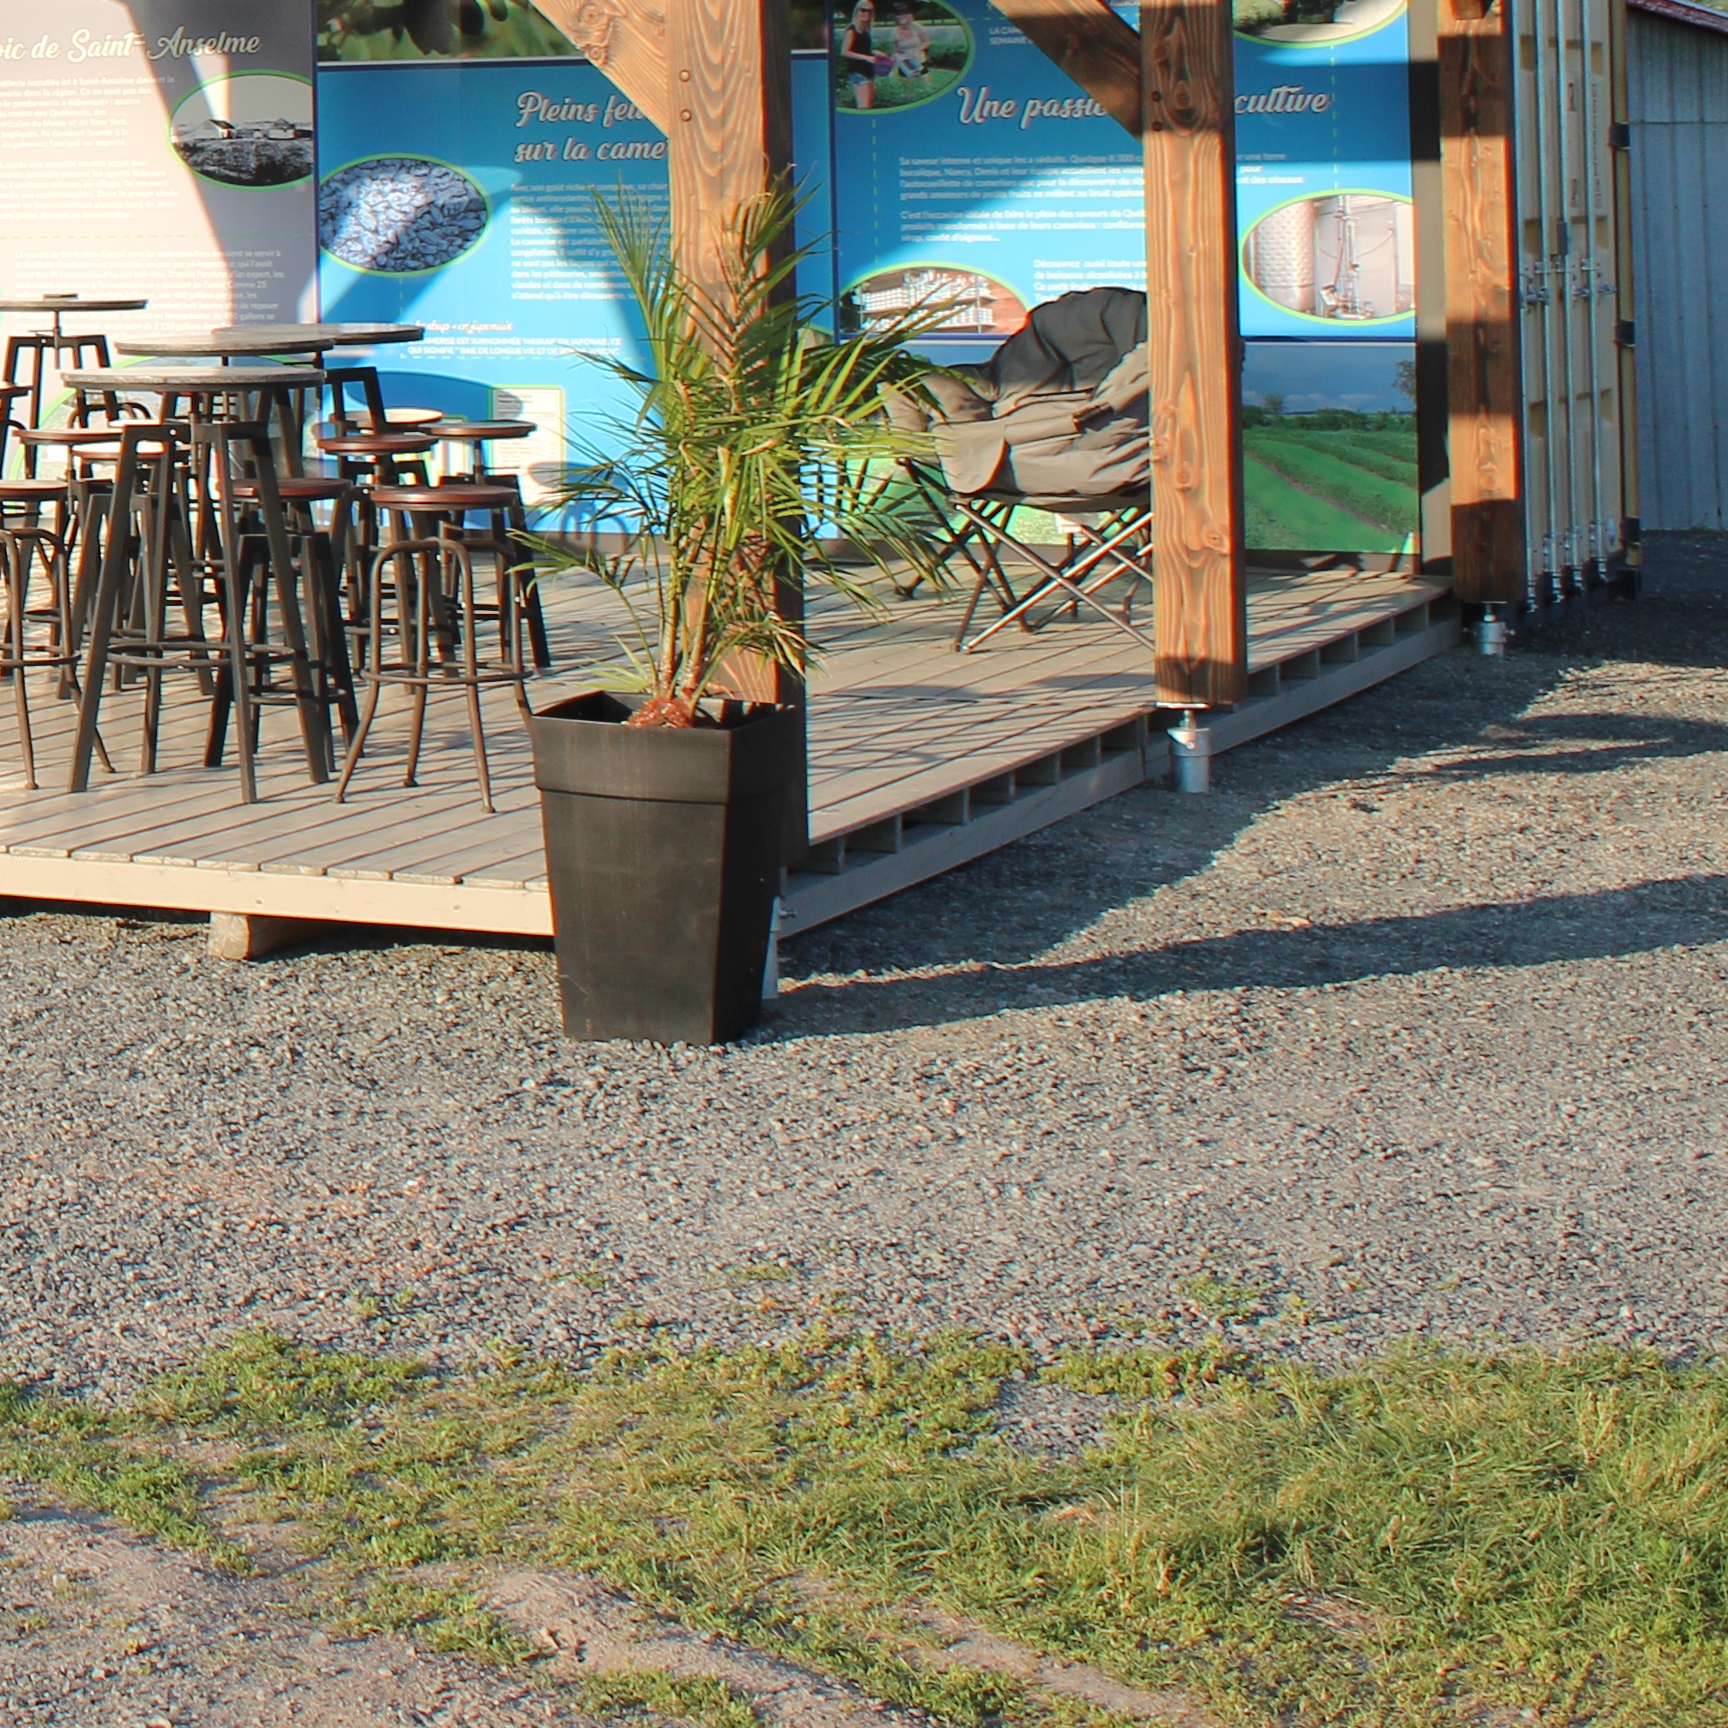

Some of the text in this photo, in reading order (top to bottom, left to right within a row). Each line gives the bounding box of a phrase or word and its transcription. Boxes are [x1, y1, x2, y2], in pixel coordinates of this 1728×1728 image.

[31, 35, 60, 59] de
[515, 90, 645, 128] Pleins feu
[956, 86, 1018, 124] Une
[1020, 96, 1108, 130] passi
[514, 135, 668, 163] sur la came
